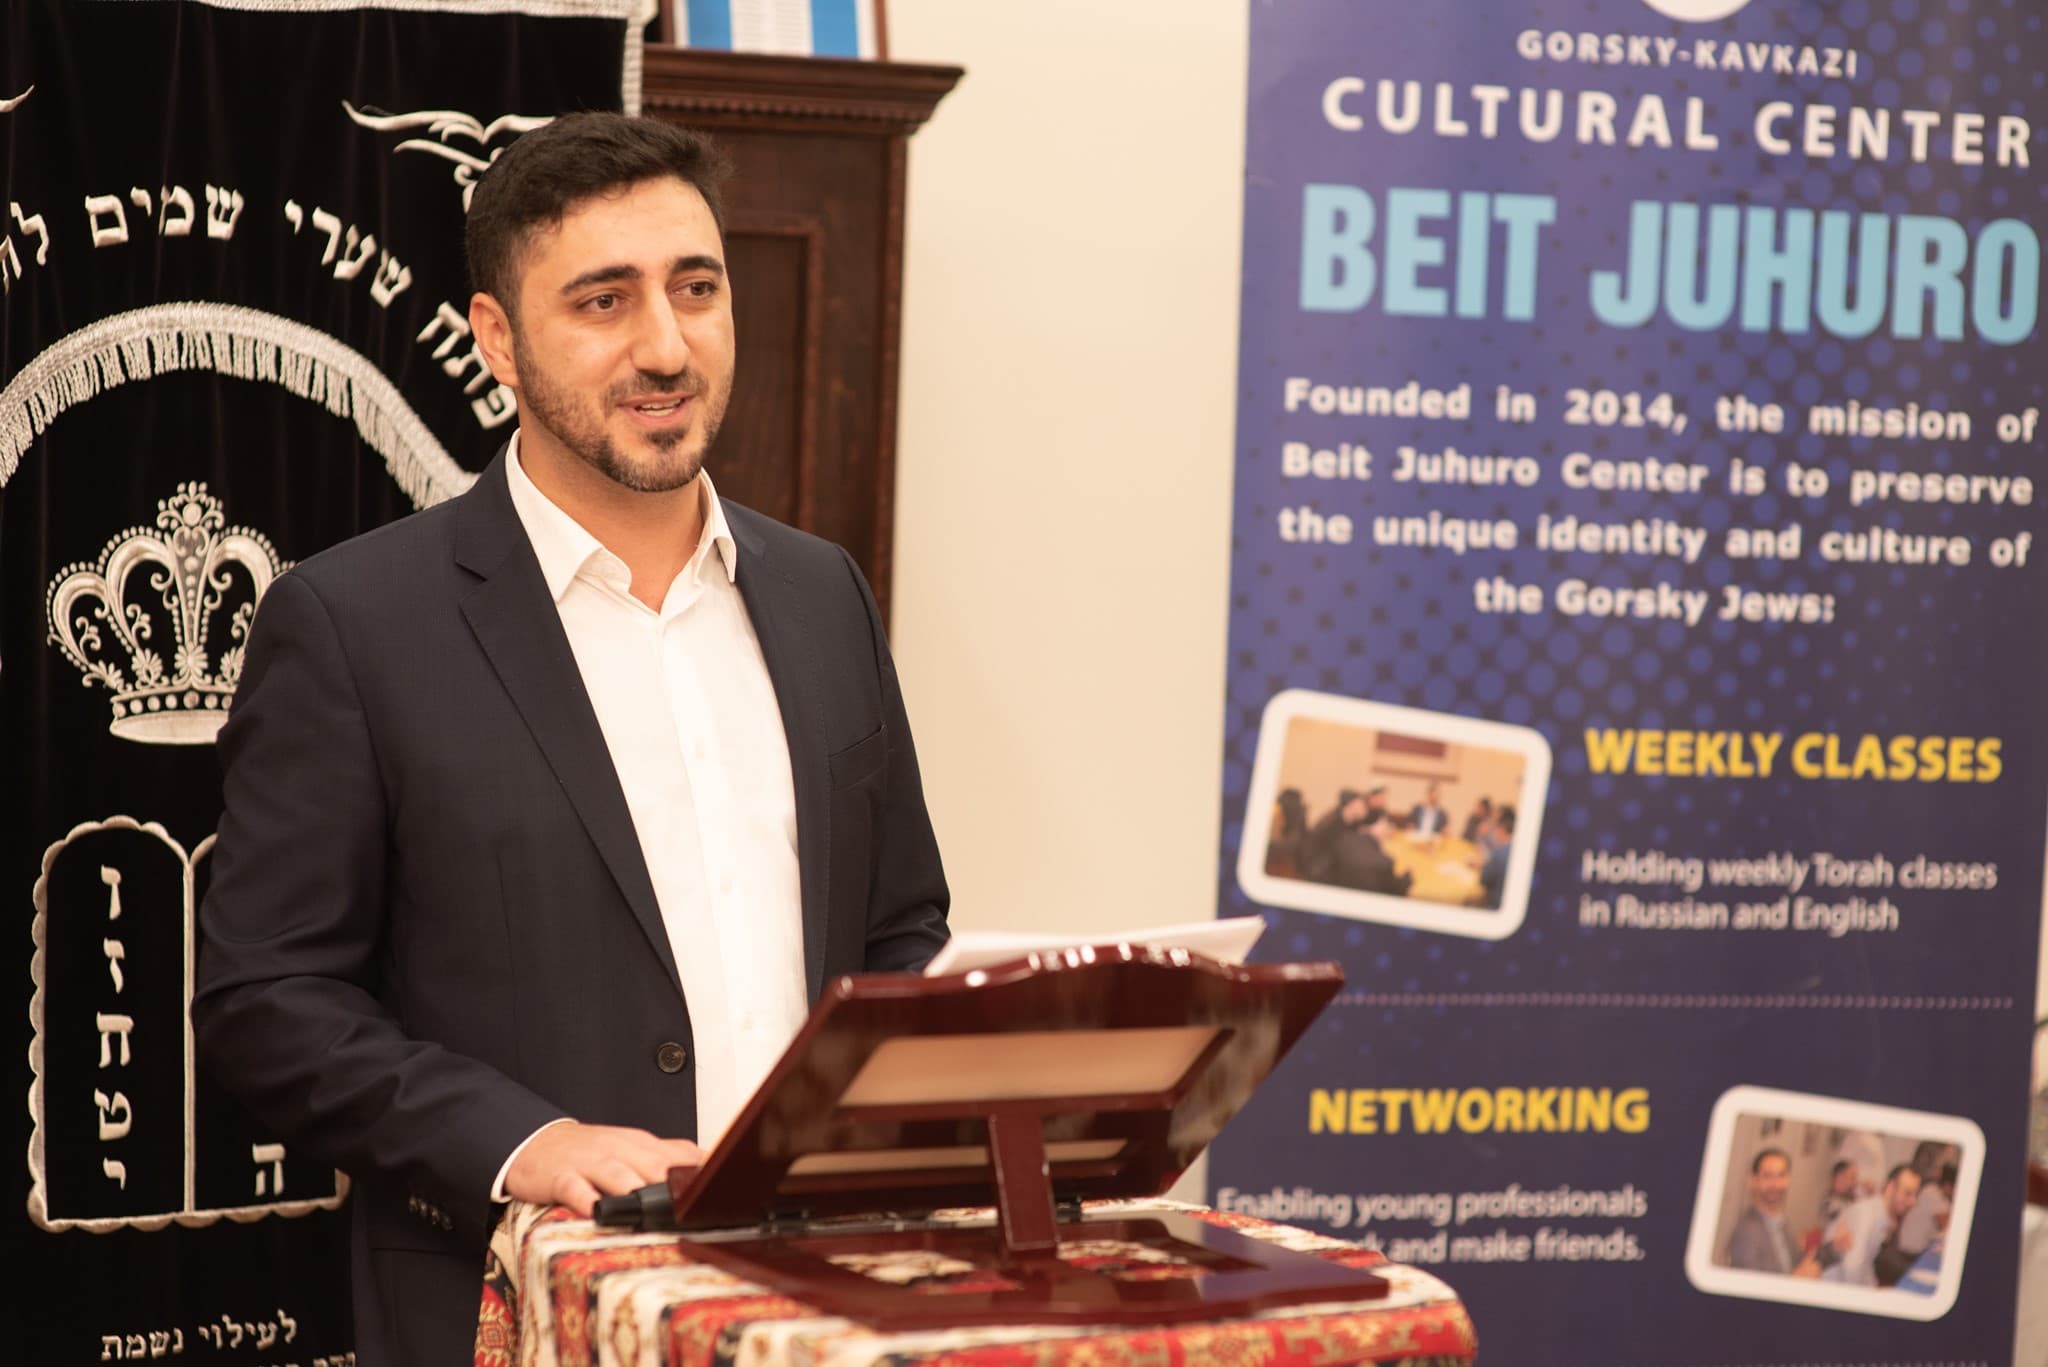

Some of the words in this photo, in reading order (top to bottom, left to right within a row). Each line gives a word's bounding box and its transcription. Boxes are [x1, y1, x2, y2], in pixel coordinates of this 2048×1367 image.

[1516, 29, 1857, 78] GORSKY-KAVKAZI
[1322, 76, 1719, 150] CULTURAL
[1754, 101, 2030, 167] CENTER
[84, 183, 244, 248] שמים
[284, 199, 412, 308] שערי
[1299, 183, 1556, 319] BEIT
[1589, 199, 2039, 343] JUHURO
[1284, 377, 1471, 419] Founded
[1496, 385, 1537, 422] in
[1564, 388, 1687, 434] 2014,
[1715, 395, 1785, 433] the
[1809, 399, 1971, 440] mission
[1996, 407, 2039, 443] of
[1282, 442, 1372, 480] Beit
[1392, 446, 1540, 486] Juhuro
[1561, 452, 1709, 492] Center
[1729, 458, 1766, 495] is
[1786, 462, 1829, 498] to
[1850, 470, 2033, 506] preserve
[1278, 506, 1353, 544] the
[1373, 510, 1518, 555] unique
[1536, 514, 1707, 563] identity
[1725, 523, 1802, 559] and
[1819, 526, 1971, 565] culture
[1989, 531, 2032, 567] of
[1474, 576, 1543, 614] the
[1555, 579, 1708, 626] Gorsky
[1719, 585, 1835, 623] Jews:
[1584, 727, 1782, 777] WEEKLY
[1791, 733, 2002, 782] CLASSES
[1581, 850, 1704, 893] Holding
[1707, 853, 1809, 893] weekly
[1813, 852, 1895, 887] Torah
[1898, 854, 1998, 889] classes
[1579, 895, 1611, 925] in
[1615, 894, 1729, 929] Russian
[1731, 896, 1790, 930] and
[1792, 896, 1899, 938] English
[1309, 1087, 1650, 1134] NETWORKING
[1216, 1186, 1353, 1229] Enabling
[1355, 1193, 1453, 1227] young
[1455, 1183, 1648, 1225] professionals
[1387, 1230, 1449, 1264] and
[1450, 1230, 1532, 1262] make
[1534, 1227, 1645, 1261] friends.
[101, 1327, 184, 1361] נשמת
[198, 1308, 297, 1349] לעילוי
